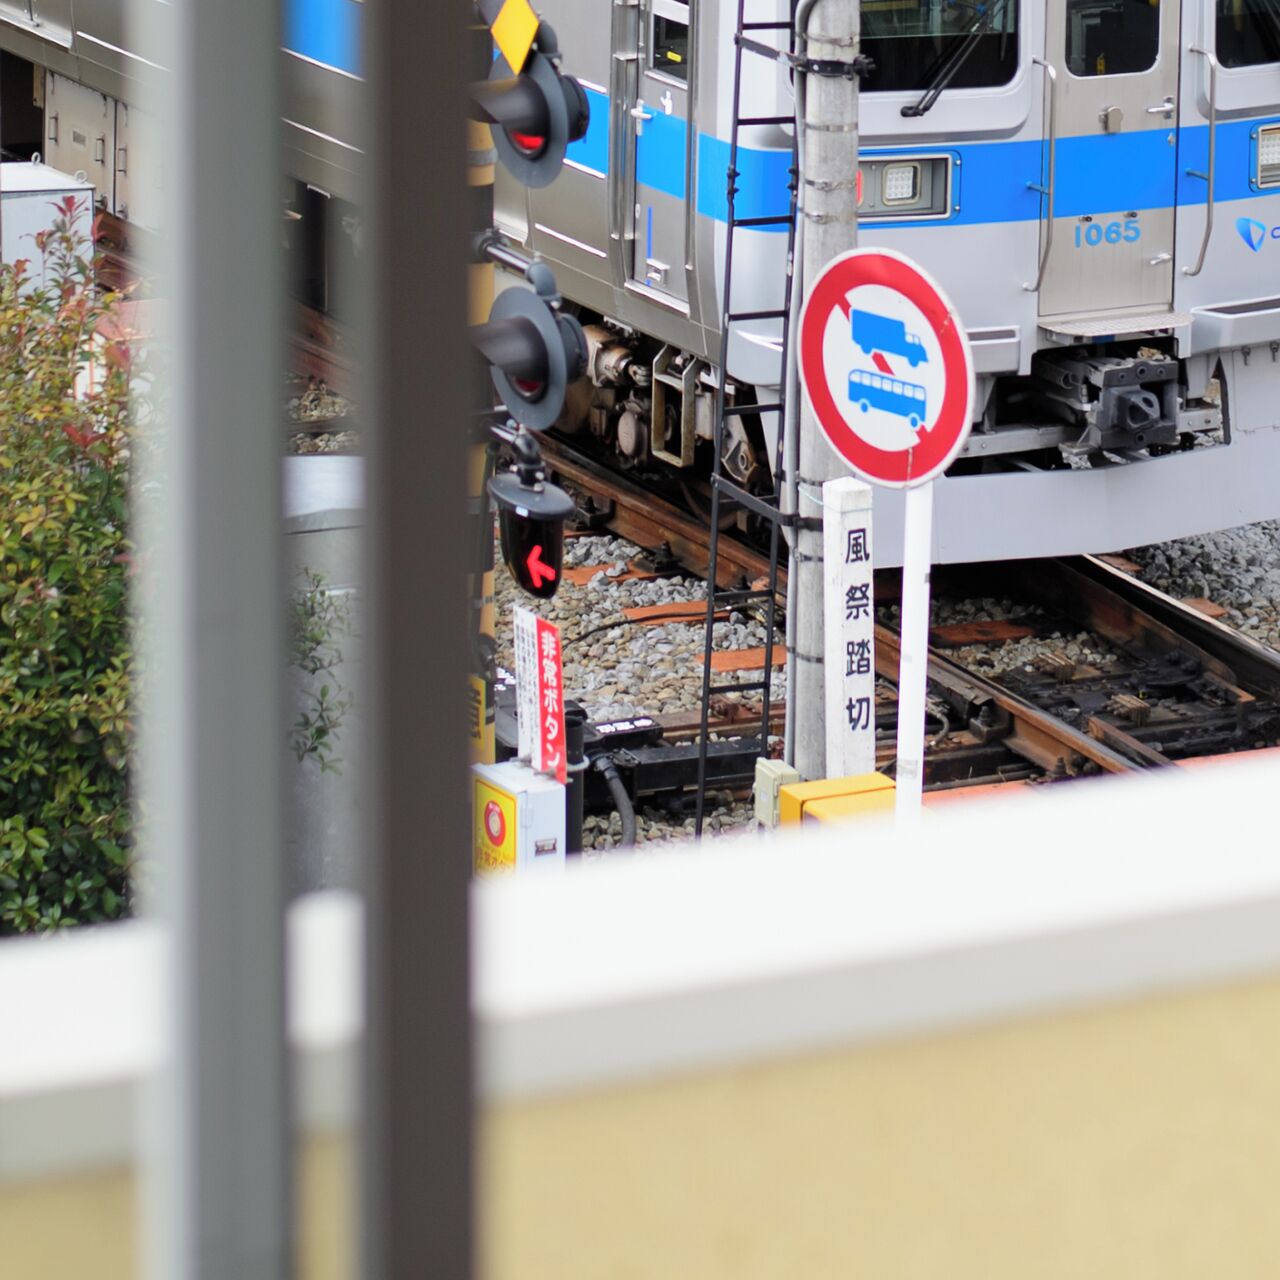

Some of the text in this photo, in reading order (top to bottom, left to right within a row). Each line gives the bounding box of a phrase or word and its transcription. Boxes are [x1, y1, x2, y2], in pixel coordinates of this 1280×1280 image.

[1074, 219, 1142, 249] 1065
[845, 527, 871, 731] 風祭踏切
[540, 630, 562, 768] 非常ボタン
